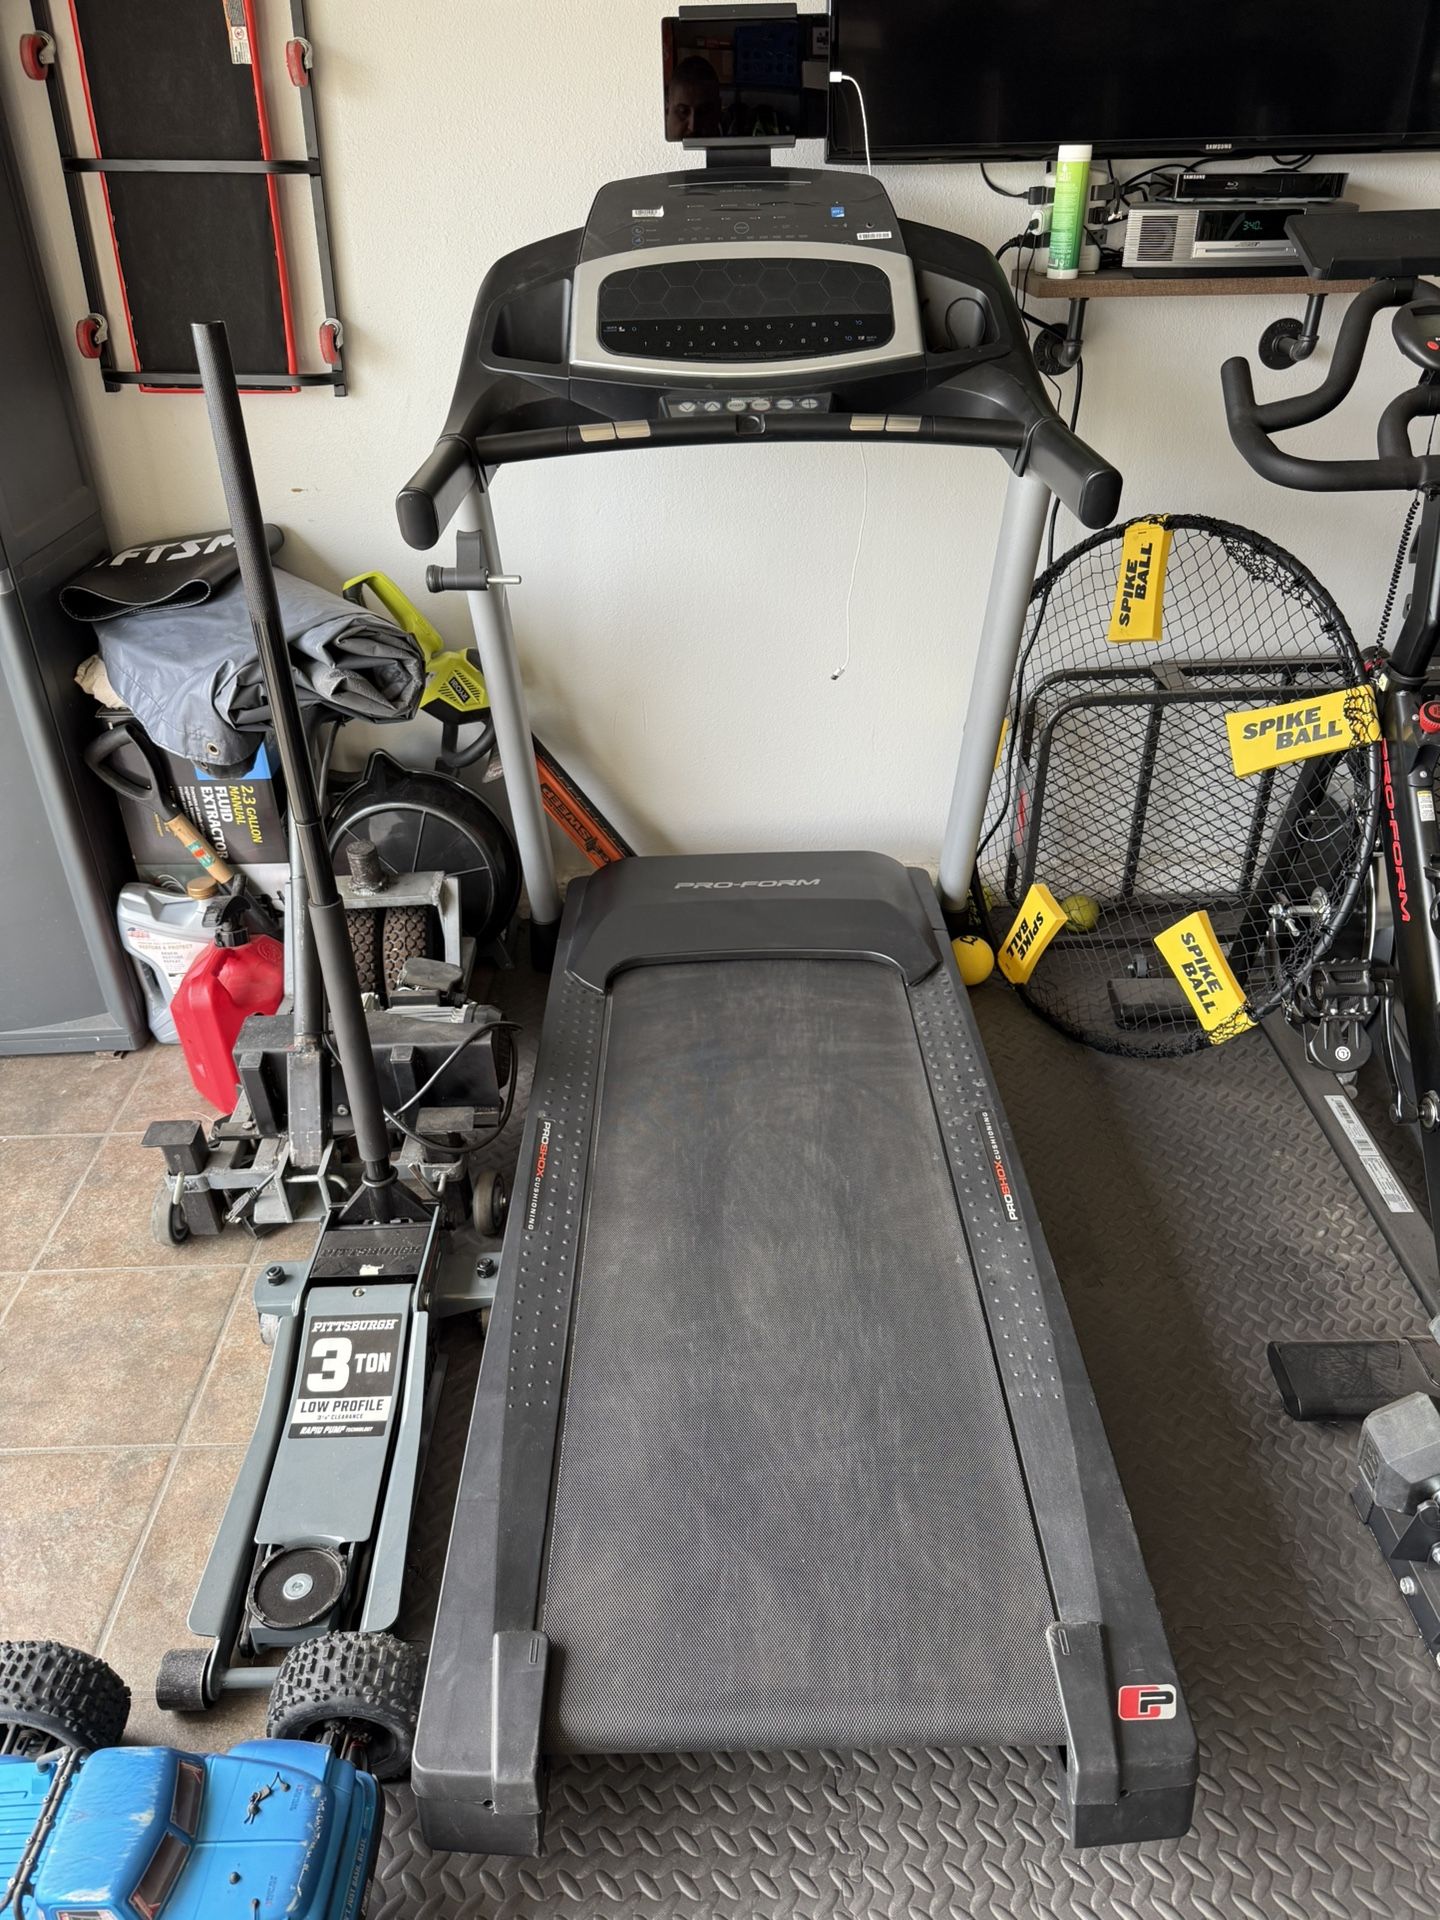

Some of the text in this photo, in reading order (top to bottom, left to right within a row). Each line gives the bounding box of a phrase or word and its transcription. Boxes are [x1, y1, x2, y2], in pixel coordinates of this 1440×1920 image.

[93, 534, 236, 568] FTSM
[1134, 543, 1153, 600] BALL
[1119, 559, 1138, 627] SPIKE
[450, 678, 469, 701] RYOBI
[1242, 706, 1321, 740] SPIKE
[1276, 720, 1342, 750] BALL
[200, 786, 229, 859] EXTRACTOR
[214, 786, 234, 823] FLUID
[228, 785, 246, 825] MANUAL
[241, 785, 263, 844] 2.3 GALLON
[674, 879, 821, 889] PRO-FORM
[1006, 917, 1029, 958] BALL
[1017, 911, 1044, 961] SPIKE
[1181, 932, 1223, 993] SPIKE
[1181, 962, 1216, 1014] BALL
[527, 1121, 552, 1230] PROSHOX CUSHIONING
[982, 1111, 1018, 1221] PROSHOX CUSHIONING
[311, 1319, 399, 1332] PITTSBURGH
[306, 1337, 391, 1392] 3 TON
[300, 1399, 384, 1413] LOW PROFILE
[323, 1426, 346, 1434] PUMP
